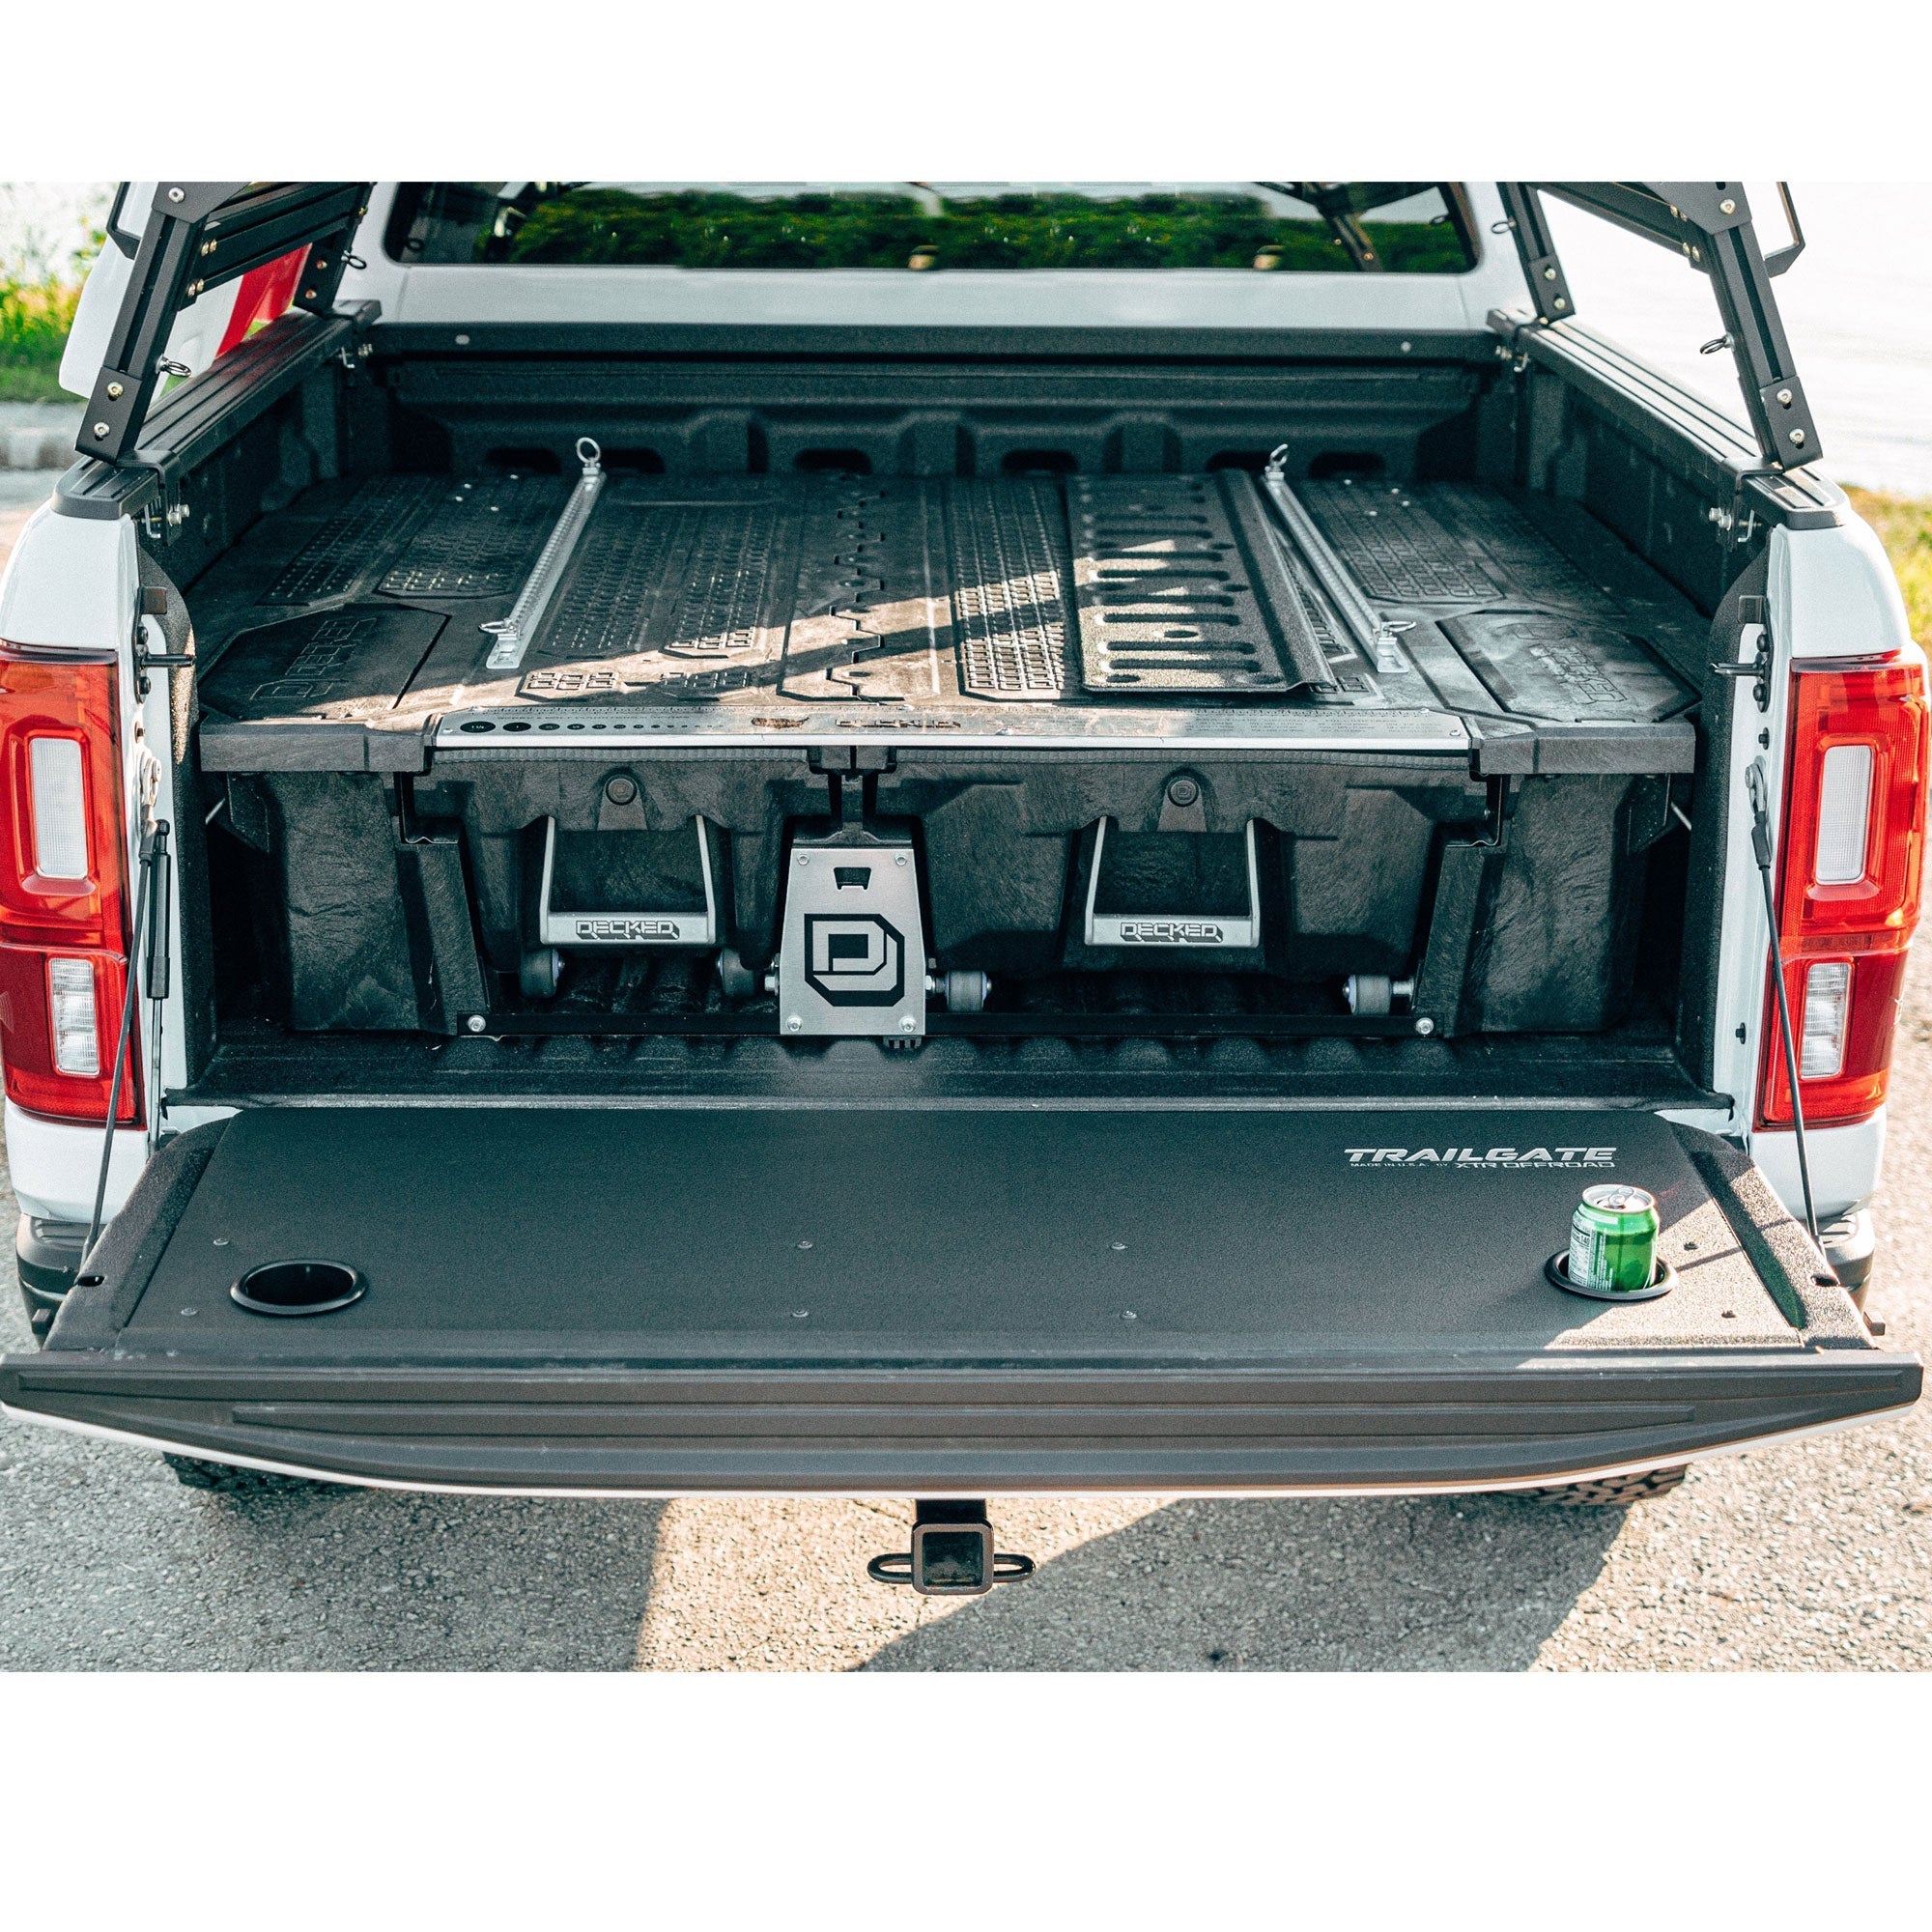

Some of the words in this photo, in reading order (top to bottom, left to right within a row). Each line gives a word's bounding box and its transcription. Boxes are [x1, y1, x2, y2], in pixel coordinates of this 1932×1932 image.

[576, 920, 680, 940] DECKED
[1120, 922, 1224, 943] DECKED
[1344, 1147, 1618, 1162] TRAILGATE
